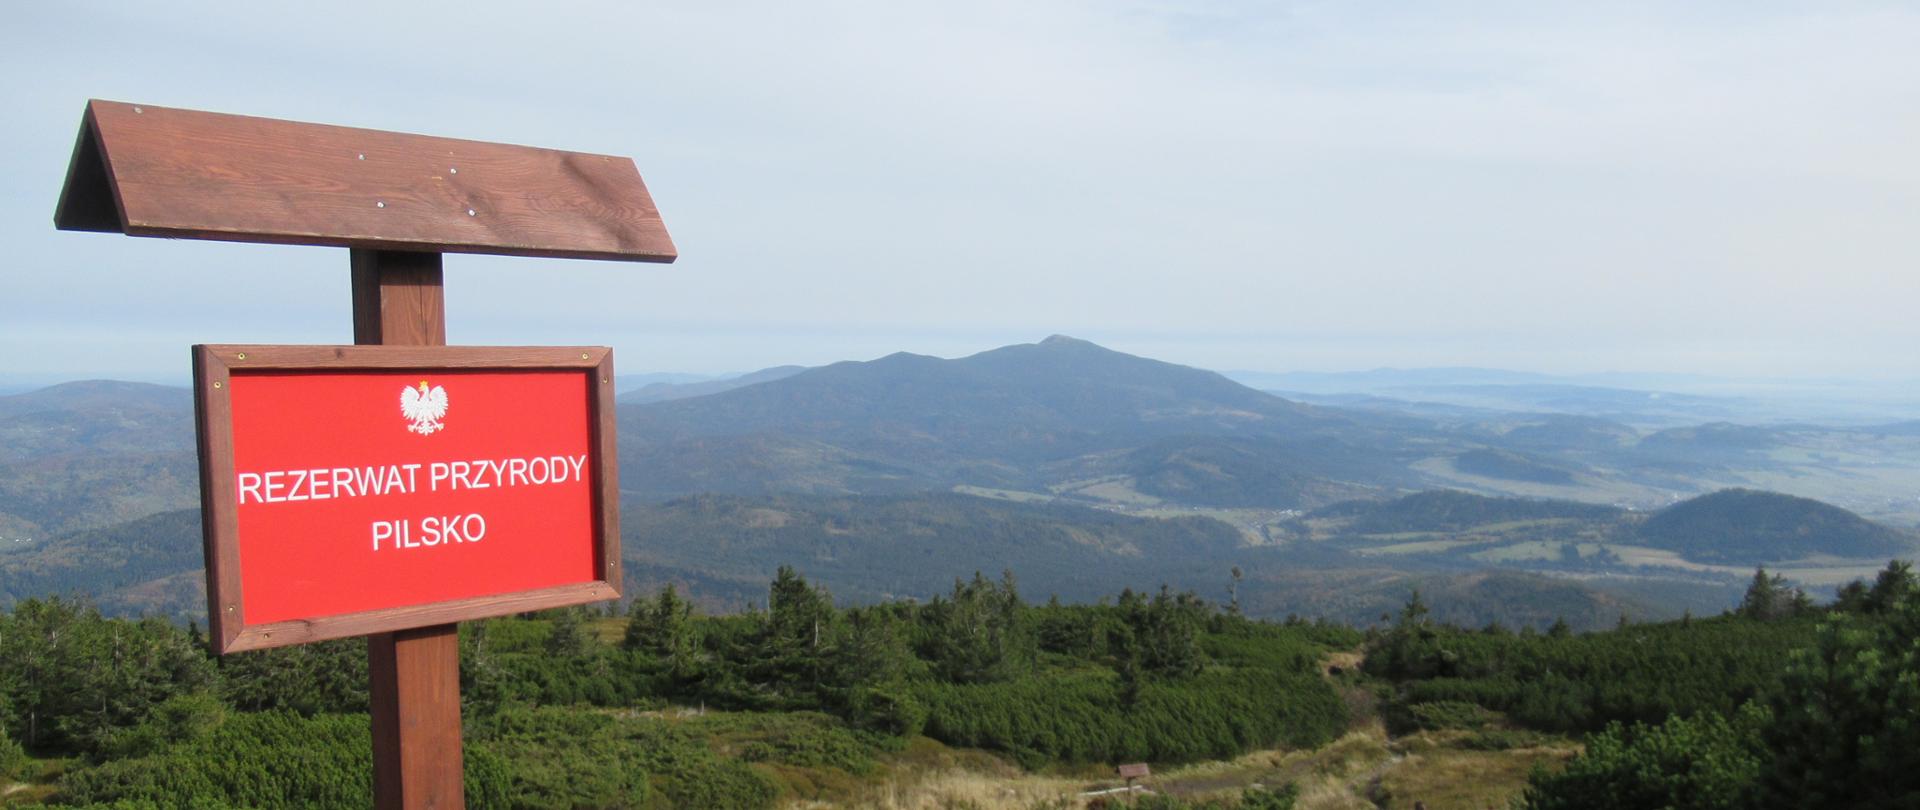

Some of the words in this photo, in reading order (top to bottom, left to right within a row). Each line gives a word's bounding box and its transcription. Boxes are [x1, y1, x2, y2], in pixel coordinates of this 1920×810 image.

[238, 463, 422, 504] REZERWAT
[430, 455, 587, 492] PRZYRODY
[372, 513, 486, 551] PILSKO
